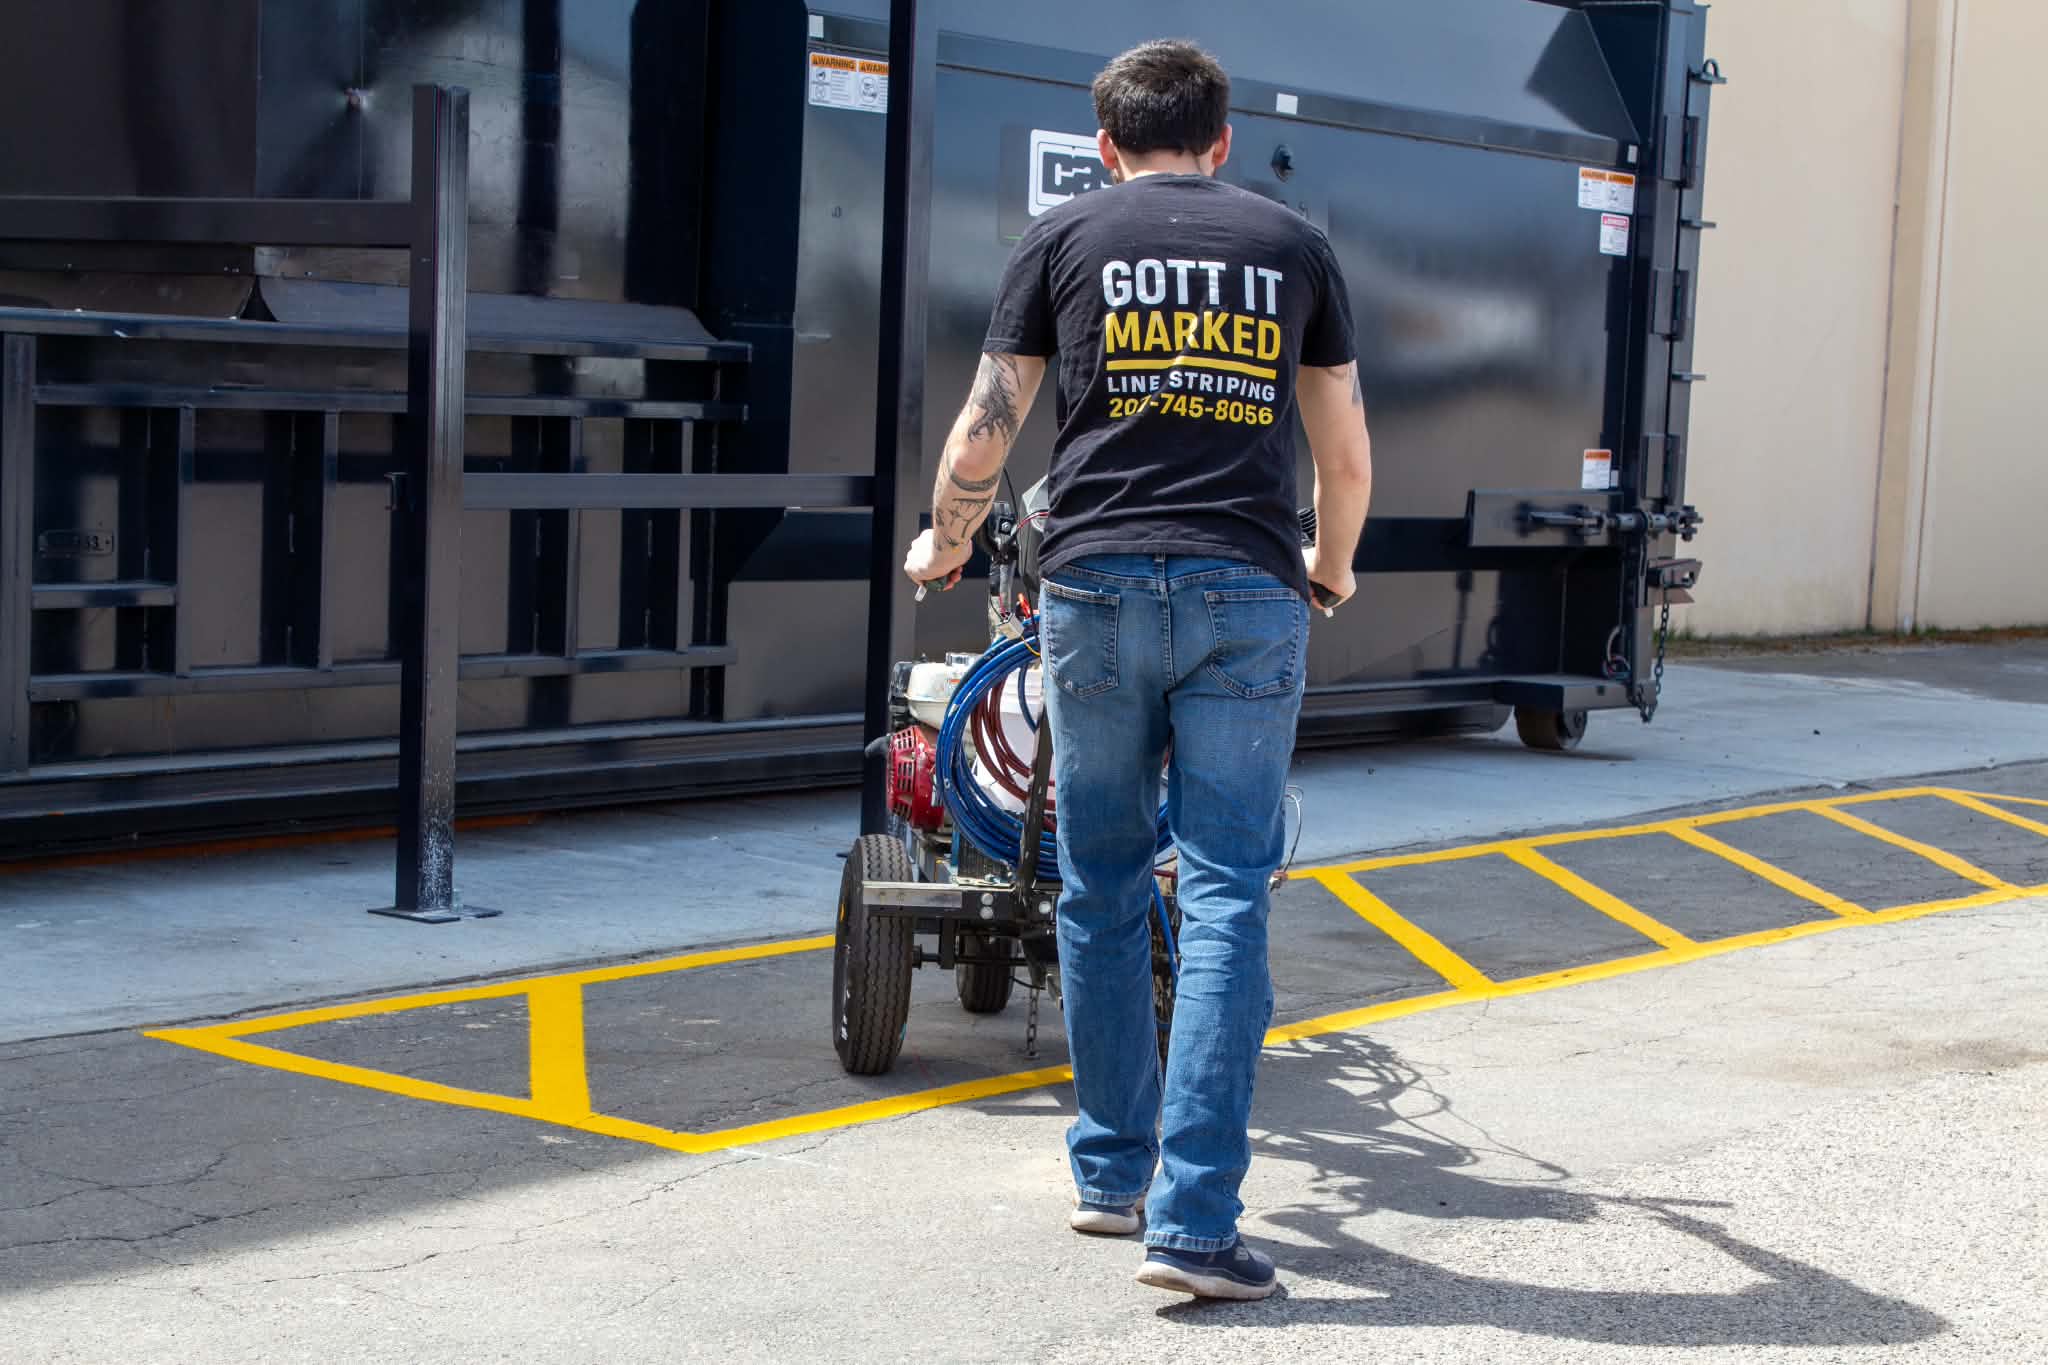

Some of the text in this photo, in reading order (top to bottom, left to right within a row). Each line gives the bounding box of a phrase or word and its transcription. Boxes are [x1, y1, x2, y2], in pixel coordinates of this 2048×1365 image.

[816, 55, 855, 70] WARNING
[1102, 258, 1283, 315] GOTT IT
[1104, 310, 1281, 361] MARKED
[1107, 370, 1276, 402] LINE STRIPING
